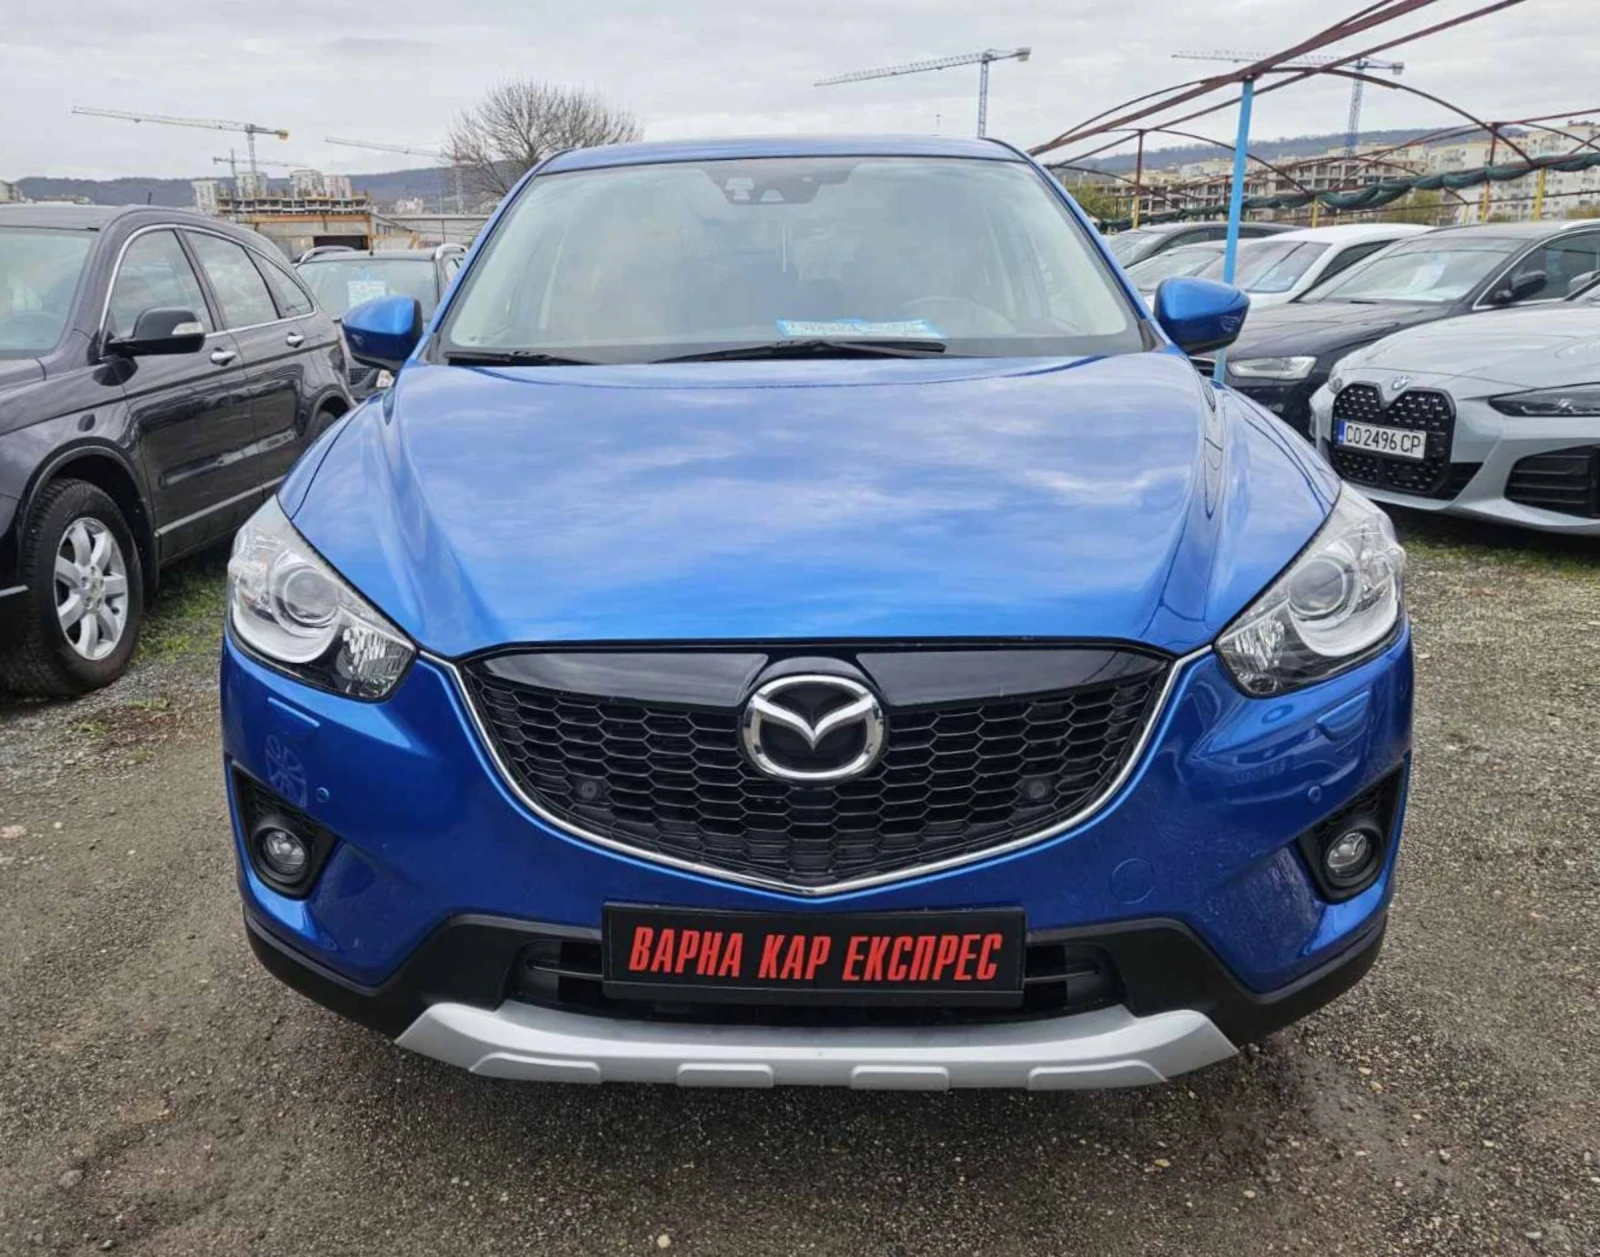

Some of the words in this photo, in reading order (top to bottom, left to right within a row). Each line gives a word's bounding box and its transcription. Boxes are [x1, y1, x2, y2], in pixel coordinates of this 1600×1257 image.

[629, 926, 744, 978] ВАРНА
[758, 934, 831, 980] КАР
[842, 933, 1003, 981] ЕКСПРЕС
